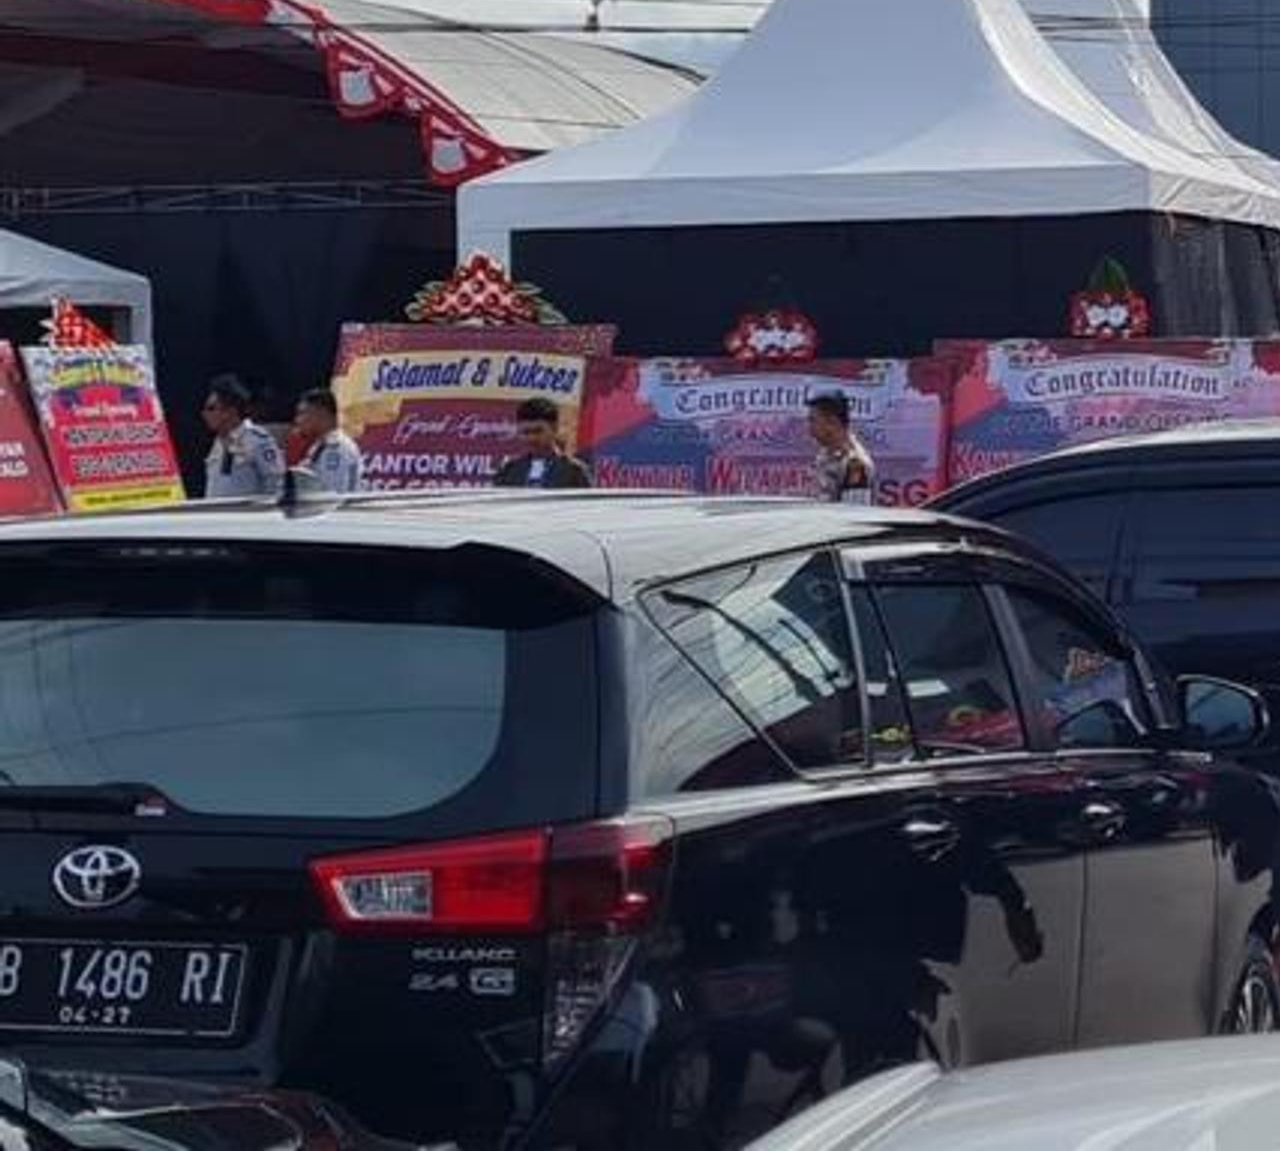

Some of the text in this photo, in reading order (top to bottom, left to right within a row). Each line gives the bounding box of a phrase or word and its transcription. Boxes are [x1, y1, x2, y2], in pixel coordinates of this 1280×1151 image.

[373, 356, 579, 393] Selamat & Sukses
[1025, 361, 1219, 397] Congratulation
[674, 385, 872, 414] Congratulon
[358, 453, 448, 474] KANTOR
[57, 947, 152, 999] 1486
[180, 951, 231, 1003] RI
